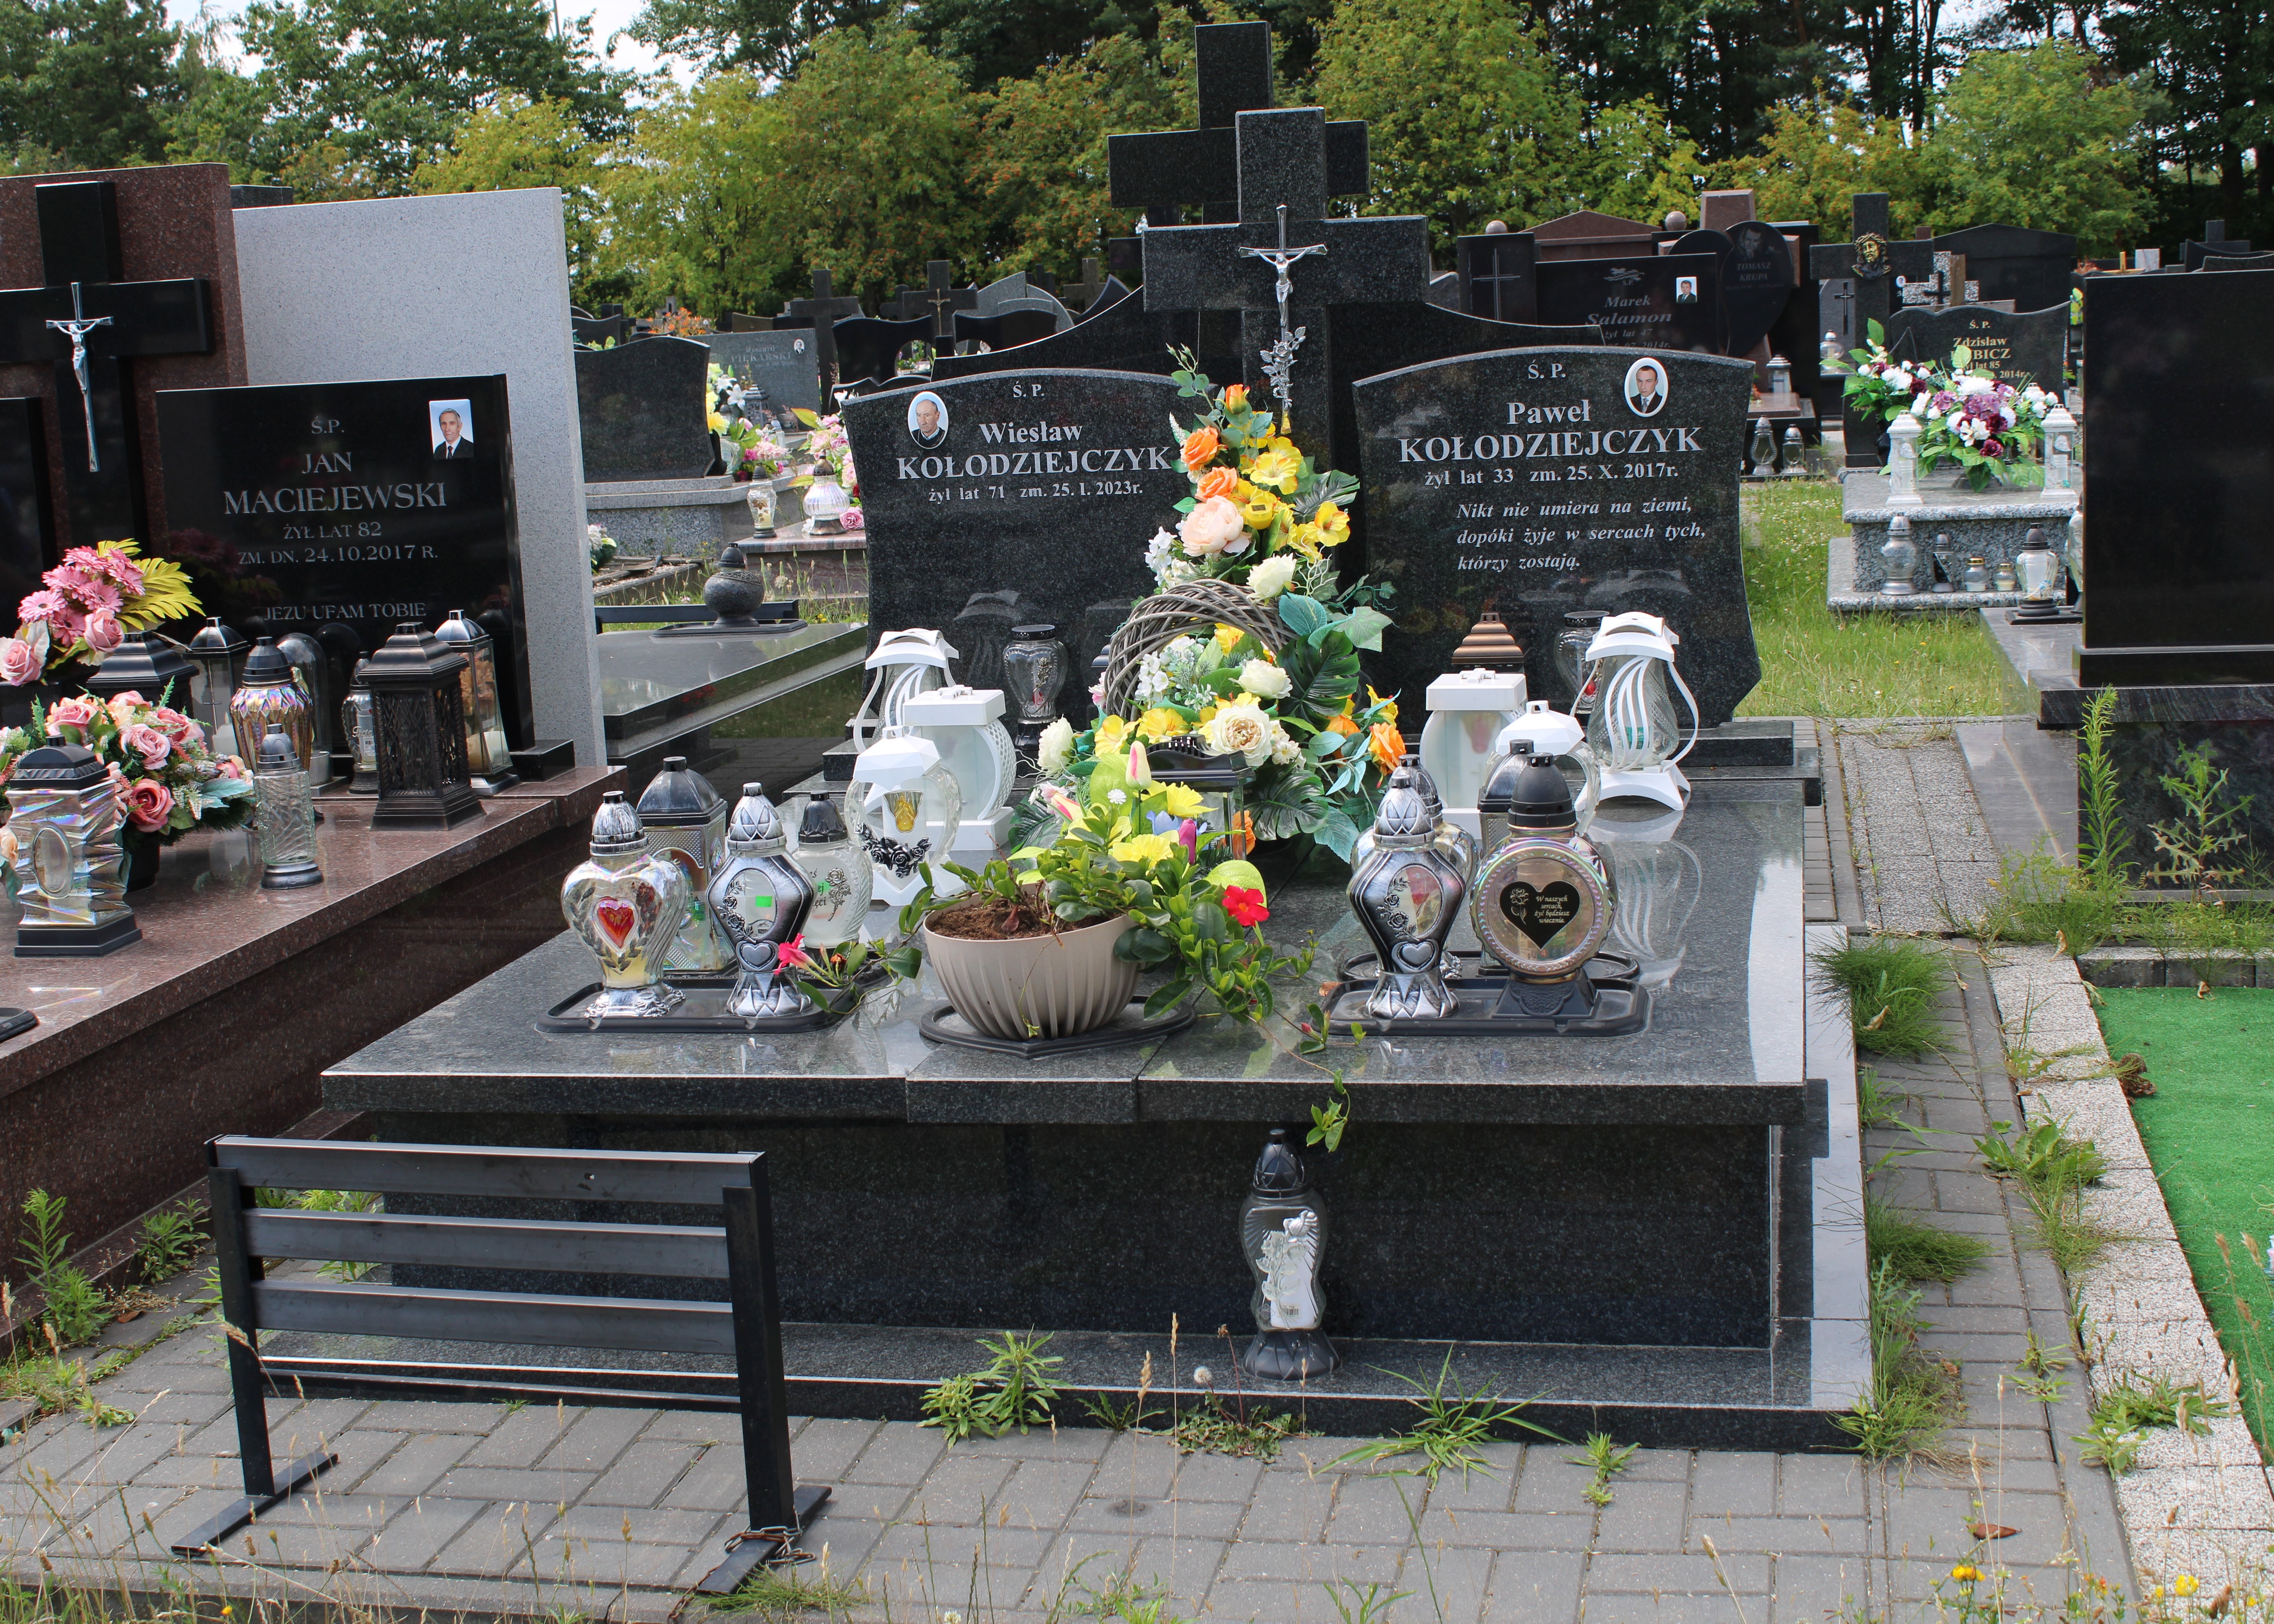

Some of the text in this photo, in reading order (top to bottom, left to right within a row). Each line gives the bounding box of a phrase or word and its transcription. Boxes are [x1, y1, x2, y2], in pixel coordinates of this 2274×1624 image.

[1737, 262, 1771, 270] TOMASZ
[1604, 295, 1651, 307] Marek
[1585, 313, 1671, 325] Salamon
[1605, 330, 1617, 339] żył
[1953, 337, 2007, 348] Zdzisław
[1989, 361, 2000, 369] 85
[1999, 370, 2026, 378] 2014r.
[1508, 399, 1591, 424] Paweł
[311, 415, 344, 434] Ś.P.
[979, 421, 1082, 444] Wiesław
[1398, 427, 1702, 462] KOŁODZIEJCZYK
[301, 452, 352, 474] JAN
[897, 446, 1172, 479] KOŁODZIEJCZYK
[1425, 462, 1678, 489] żył lat 33 zm. 25. X. 2017r.
[224, 482, 446, 515] MACIEJEWSKI
[929, 488, 950, 504] żył
[960, 487, 979, 500] lat
[988, 485, 1005, 498] 71
[1020, 487, 1047, 498] zm.
[1053, 483, 1075, 497] 25.
[1096, 480, 1143, 495] 2023r.
[1457, 496, 1691, 518] Nikt nie umiera na ziemi,
[283, 521, 382, 539] ŻYŁ LAT 82
[1457, 522, 1706, 547] dopóki żyje w sercach tych,
[237, 544, 438, 565] ZM. DN. 24.10.2017 R.
[1458, 553, 1580, 573] którzy zostają.
[264, 602, 427, 620] JEZU UFAM TOBIE
[1545, 895, 1567, 904] naszych
[1546, 909, 1570, 917] będziesz
